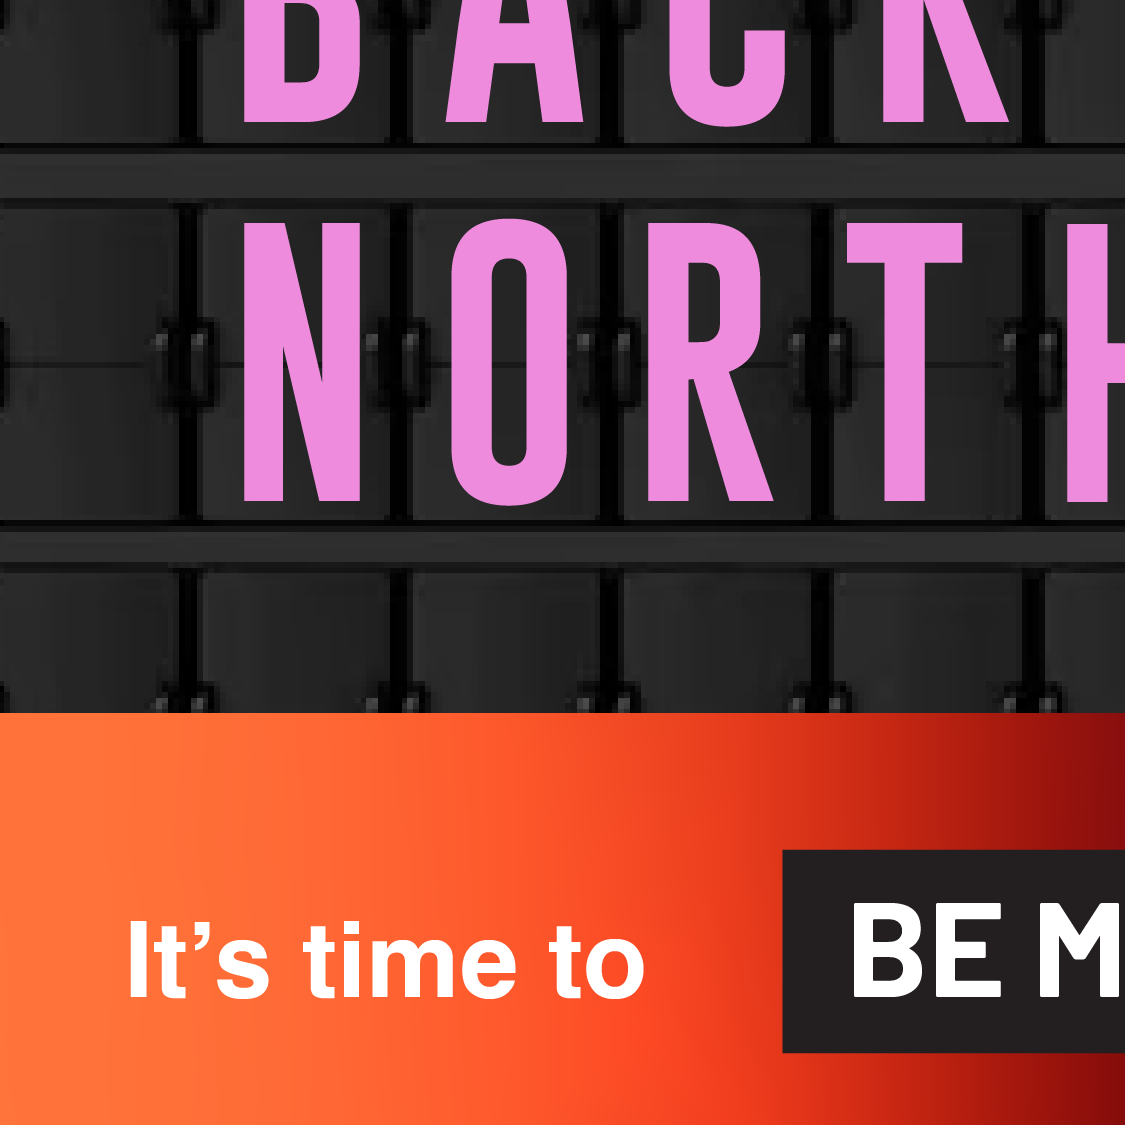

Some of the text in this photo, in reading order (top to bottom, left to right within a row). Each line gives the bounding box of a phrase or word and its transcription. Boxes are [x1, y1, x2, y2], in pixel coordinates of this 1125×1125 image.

[130, 921, 644, 999] It’s time to
[854, 903, 1000, 997] BE
